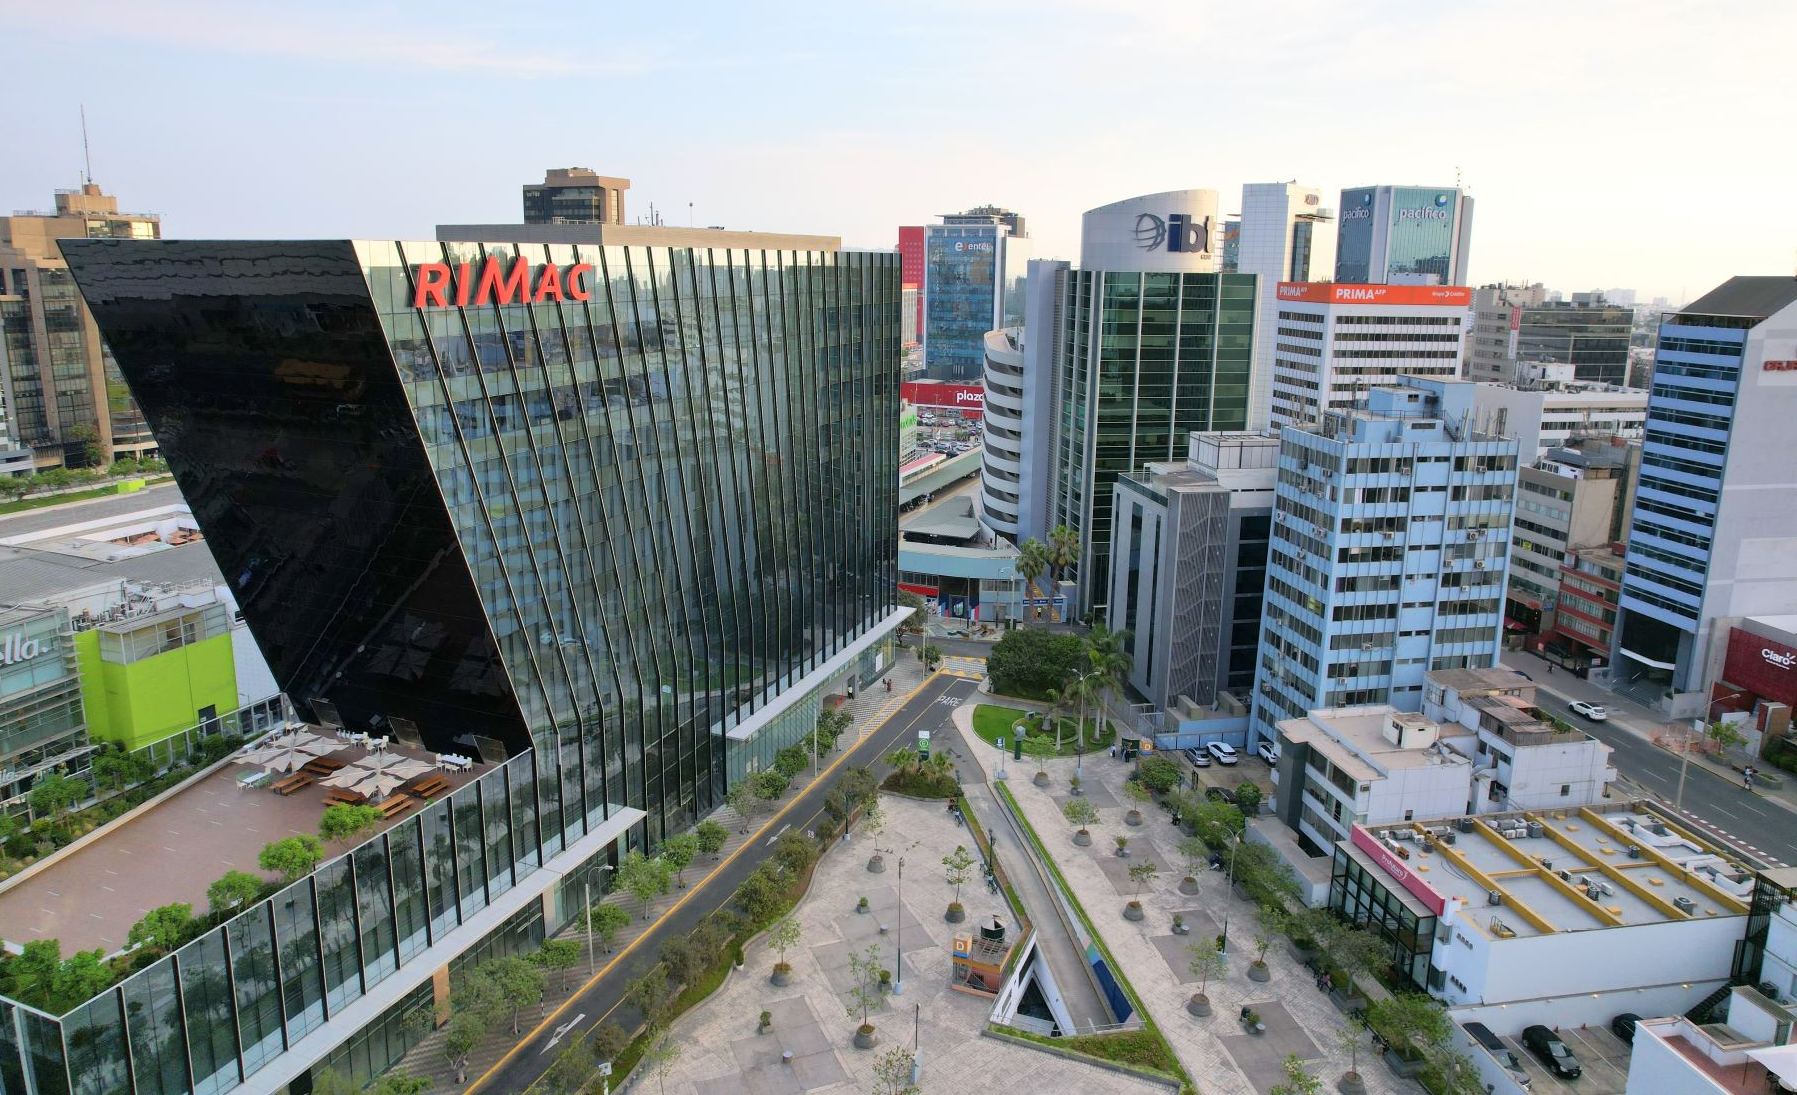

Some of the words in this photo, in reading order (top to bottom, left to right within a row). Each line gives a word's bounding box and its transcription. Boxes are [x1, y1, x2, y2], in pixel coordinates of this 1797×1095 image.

[414, 255, 593, 308] RIMAC
[1762, 649, 1790, 665] Claro
[936, 695, 963, 707] PARE
[956, 941, 965, 951] D
